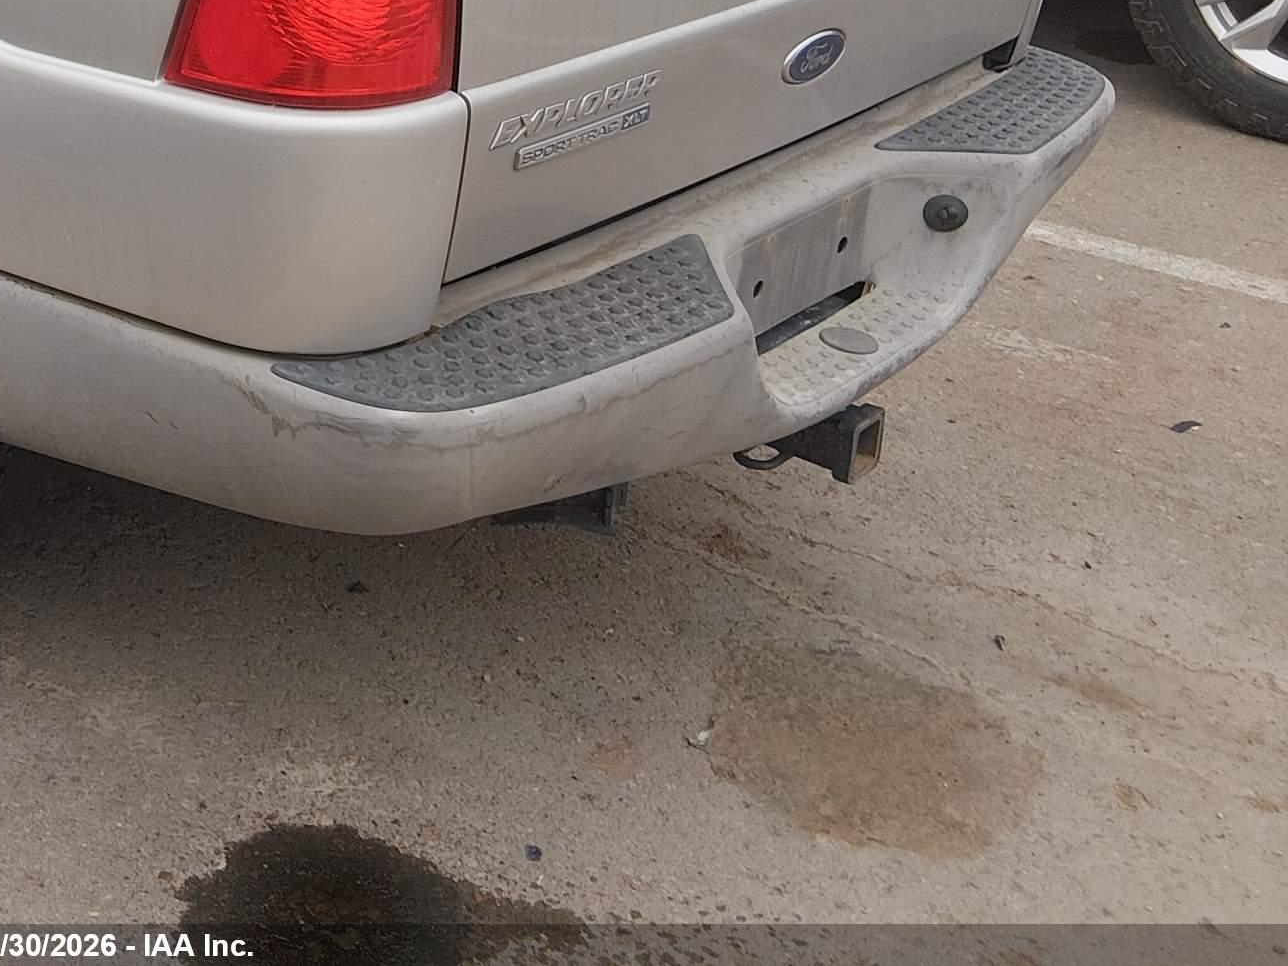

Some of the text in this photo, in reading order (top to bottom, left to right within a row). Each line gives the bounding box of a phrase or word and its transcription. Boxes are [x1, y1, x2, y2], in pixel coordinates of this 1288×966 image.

[799, 42, 834, 74] Ford
[489, 68, 663, 150] EXPLORER
[520, 108, 649, 165] SPORT TRAC XLT
